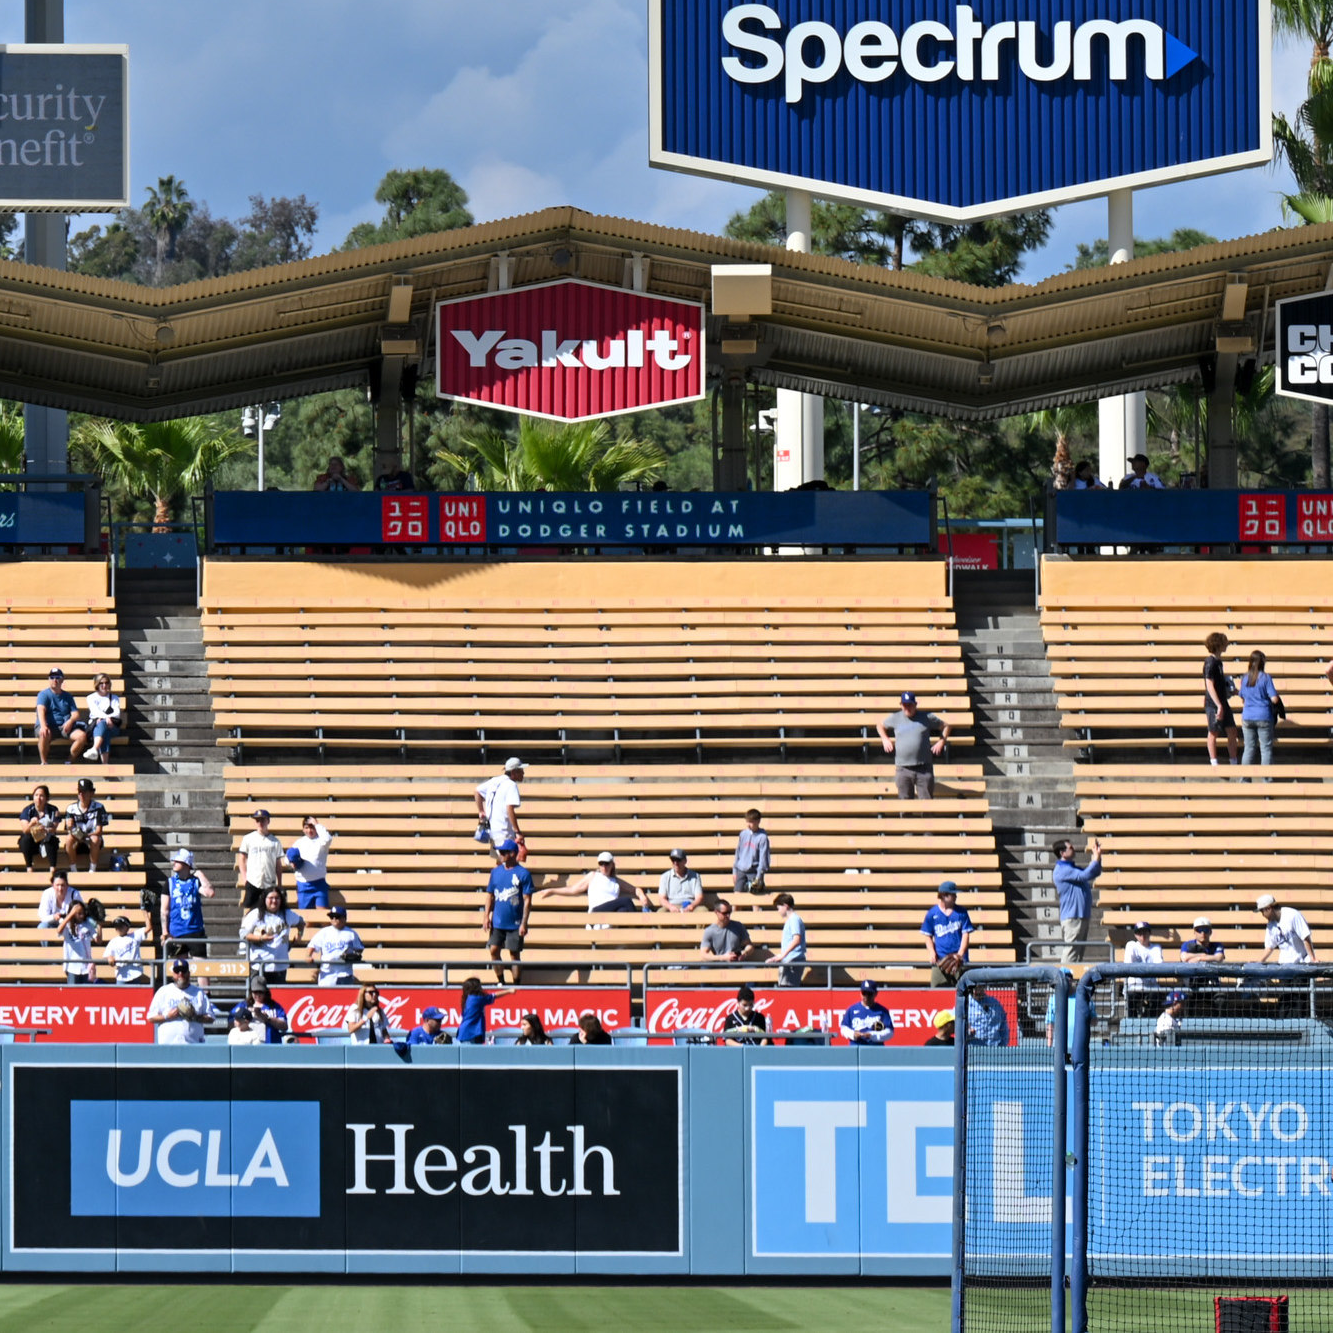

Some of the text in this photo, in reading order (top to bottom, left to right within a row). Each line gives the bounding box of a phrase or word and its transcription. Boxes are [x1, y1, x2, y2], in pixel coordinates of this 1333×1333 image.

[721, 3, 1164, 103] Spectrum
[450, 330, 691, 370] Yakult
[445, 501, 478, 517] UNI
[498, 499, 740, 515] UNIQLO FIELD AT
[445, 521, 481, 538] QLO
[498, 524, 745, 539] DODGER STADIUM
[219, 963, 238, 974] 311
[84, 1006, 148, 1026] TIME
[544, 1009, 619, 1026] MAGIC
[782, 1009, 800, 1027] A
[1131, 1100, 1309, 1144] TOKYO
[106, 1127, 289, 1188] UCLA
[345, 1123, 621, 1197] Health
[774, 1100, 1073, 1223] TEL
